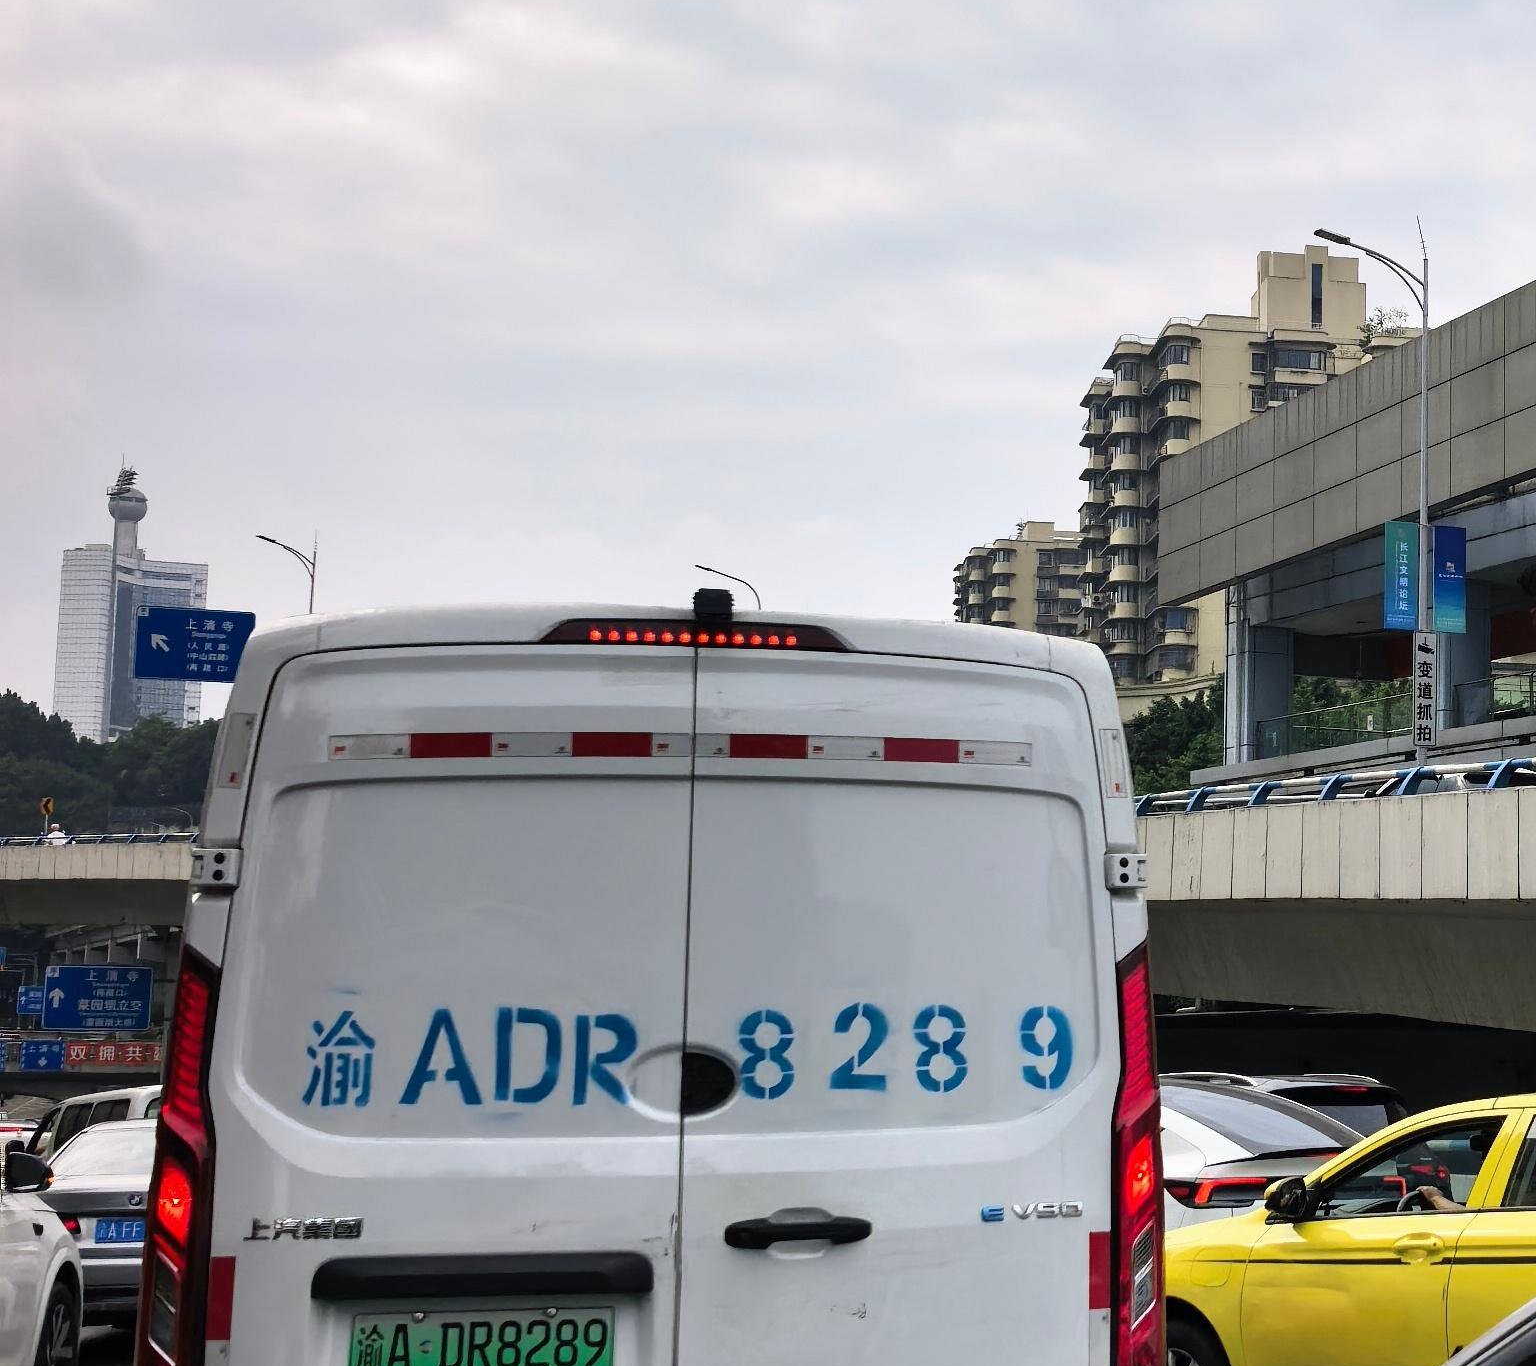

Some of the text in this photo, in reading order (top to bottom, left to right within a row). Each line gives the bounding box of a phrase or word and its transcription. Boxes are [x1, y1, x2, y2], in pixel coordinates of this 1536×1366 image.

[1400, 541, 1409, 611] 长江文明论坛
[185, 618, 234, 632] 上清寺
[1417, 661, 1433, 742] 变道抓拍
